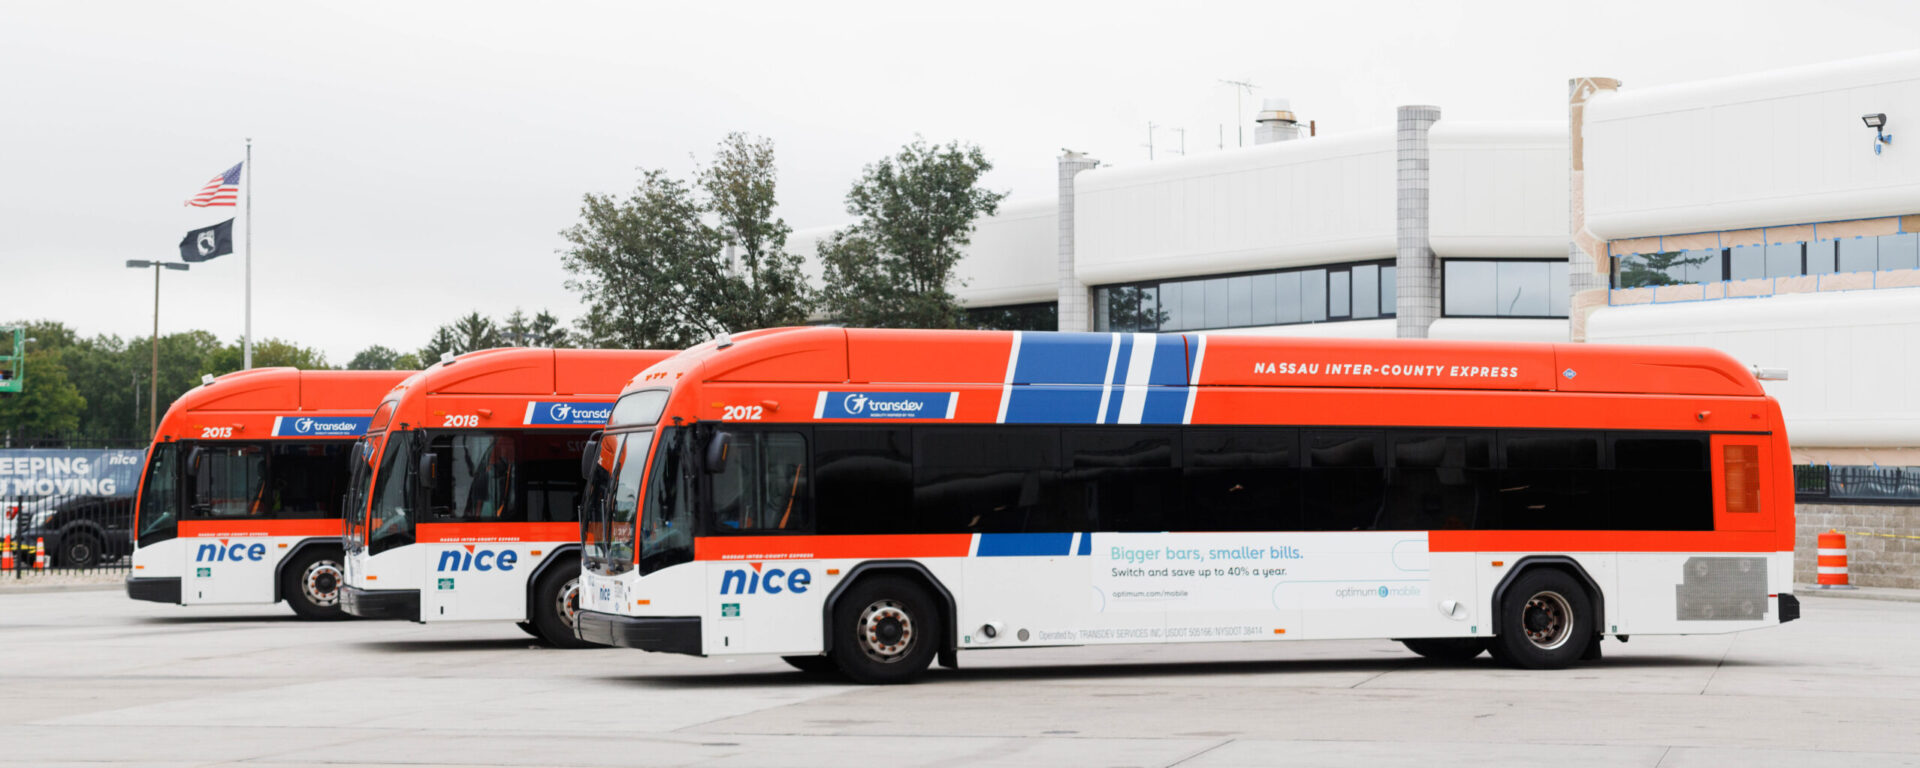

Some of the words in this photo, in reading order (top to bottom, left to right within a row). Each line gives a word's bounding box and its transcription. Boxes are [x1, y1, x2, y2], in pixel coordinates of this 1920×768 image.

[1254, 362, 1319, 374] NASSAU
[1325, 363, 1444, 377] INTER-COUNTY
[1450, 366, 1519, 378] EXPRESS
[868, 399, 923, 411] transdev
[722, 405, 763, 420] 2012
[313, 421, 357, 431] transdev
[443, 415, 479, 427] 2018
[201, 427, 233, 438] 2013
[109, 454, 138, 465] nice
[15, 478, 116, 496] MOVING
[195, 539, 266, 562] nice
[1111, 546, 1161, 563] Bigger
[1166, 546, 1204, 563] bars,
[1209, 546, 1265, 560] smaller
[1270, 546, 1304, 559] bills.
[437, 544, 518, 571] nice
[720, 562, 811, 595] nice
[1111, 567, 1145, 577] Switch
[1148, 567, 1167, 577] and
[1171, 569, 1195, 577] save
[1199, 569, 1212, 578] up
[1214, 568, 1225, 577] to
[1228, 567, 1249, 576] 40%
[1262, 568, 1287, 578] year.
[1112, 589, 1188, 599] optimum.com/mobile
[1335, 587, 1377, 599] optimum
[1390, 585, 1421, 596] mobile
[1080, 629, 1114, 639] TRANSDEV
[1116, 628, 1148, 638] SERVICES
